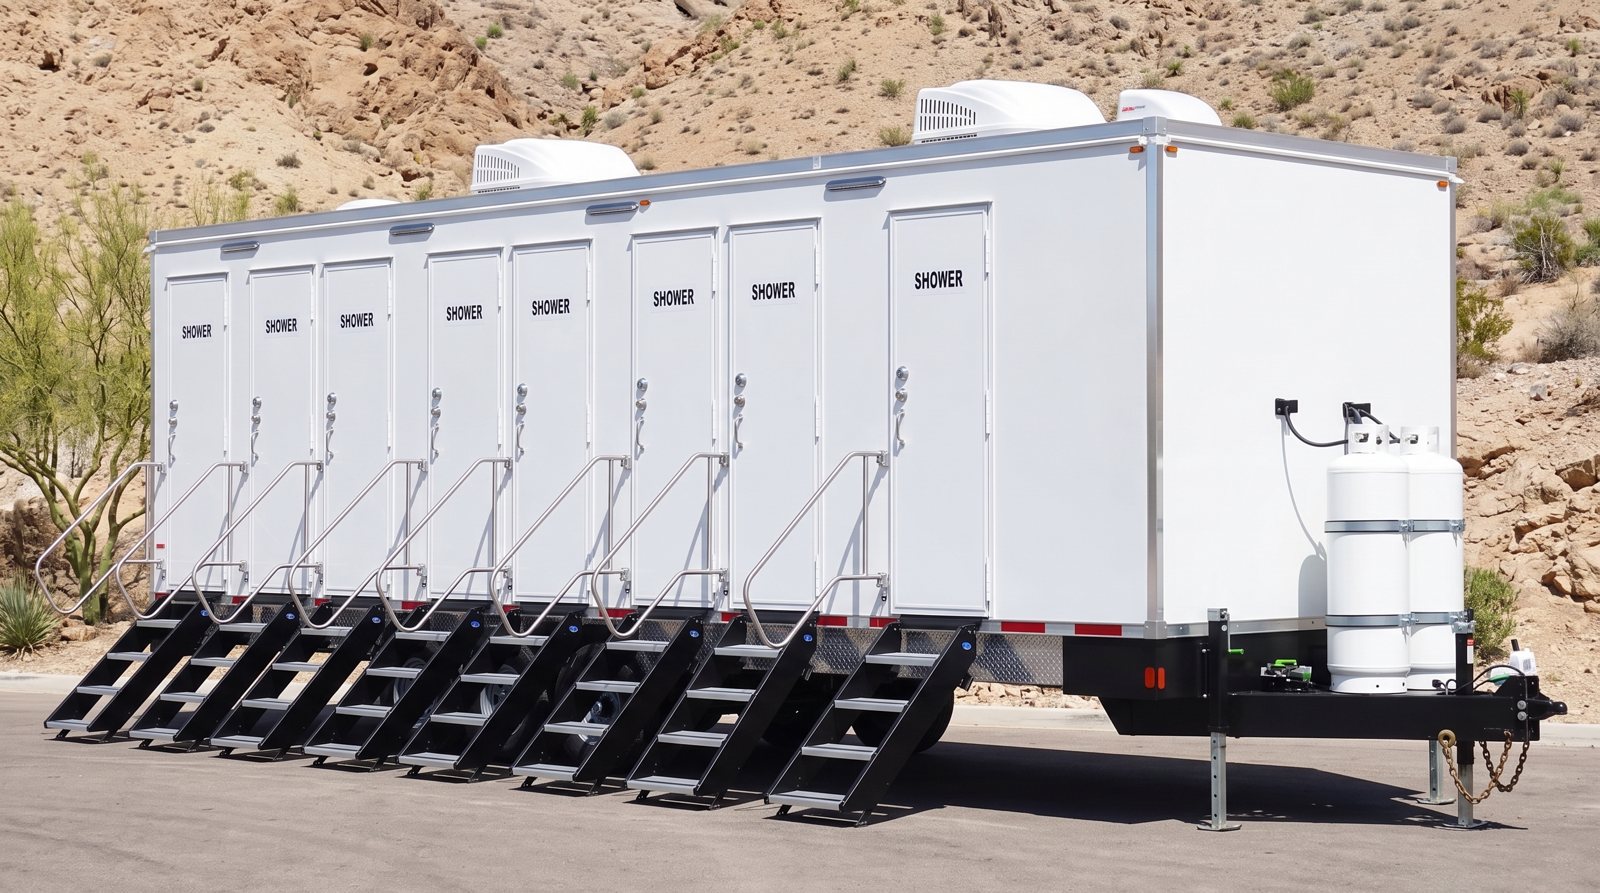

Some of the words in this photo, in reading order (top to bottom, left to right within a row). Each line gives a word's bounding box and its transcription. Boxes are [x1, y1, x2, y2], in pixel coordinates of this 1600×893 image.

[914, 269, 964, 290] SHOWER
[653, 288, 695, 308] SHOWER
[751, 281, 796, 301] SHOWER
[446, 304, 483, 322] SHOWER
[531, 298, 570, 316] SHOWER
[265, 317, 298, 334] SHOWER
[340, 312, 374, 329] SHOWER
[182, 323, 212, 340] SHOWER
